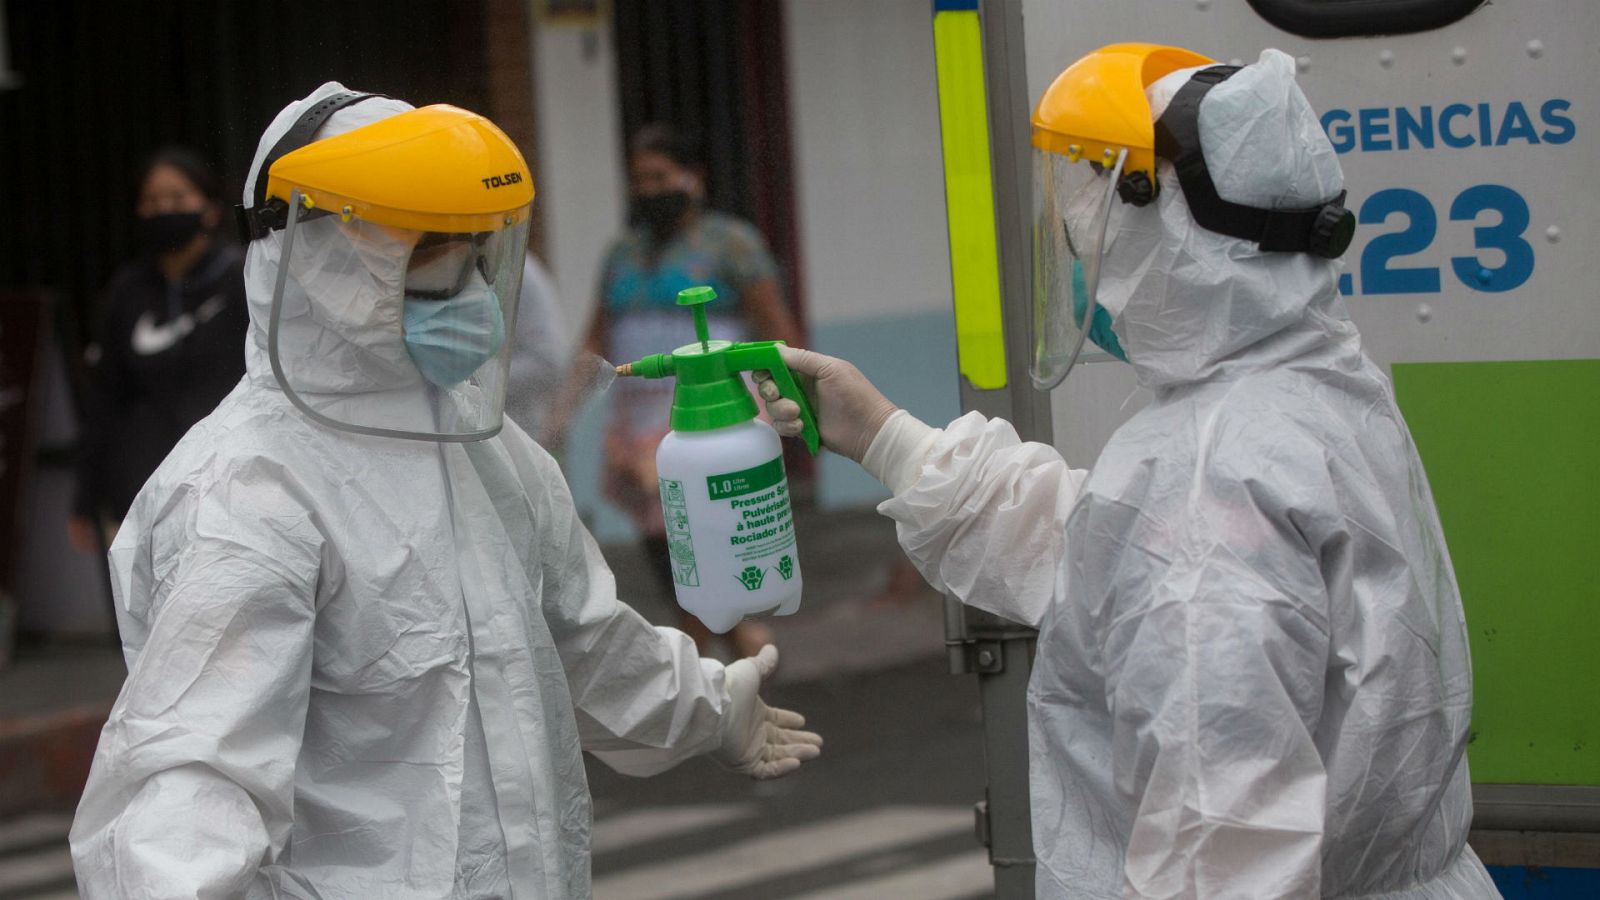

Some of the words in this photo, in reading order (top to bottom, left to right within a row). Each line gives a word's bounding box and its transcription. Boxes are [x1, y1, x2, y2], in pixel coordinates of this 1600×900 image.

[482, 171, 523, 190] TOLSEN
[1338, 184, 1535, 295] 23
[711, 479, 732, 495] 1.0
[731, 490, 776, 510] Pressure
[736, 521, 745, 532] à
[746, 514, 776, 530] haute
[730, 526, 778, 546] Rociador
